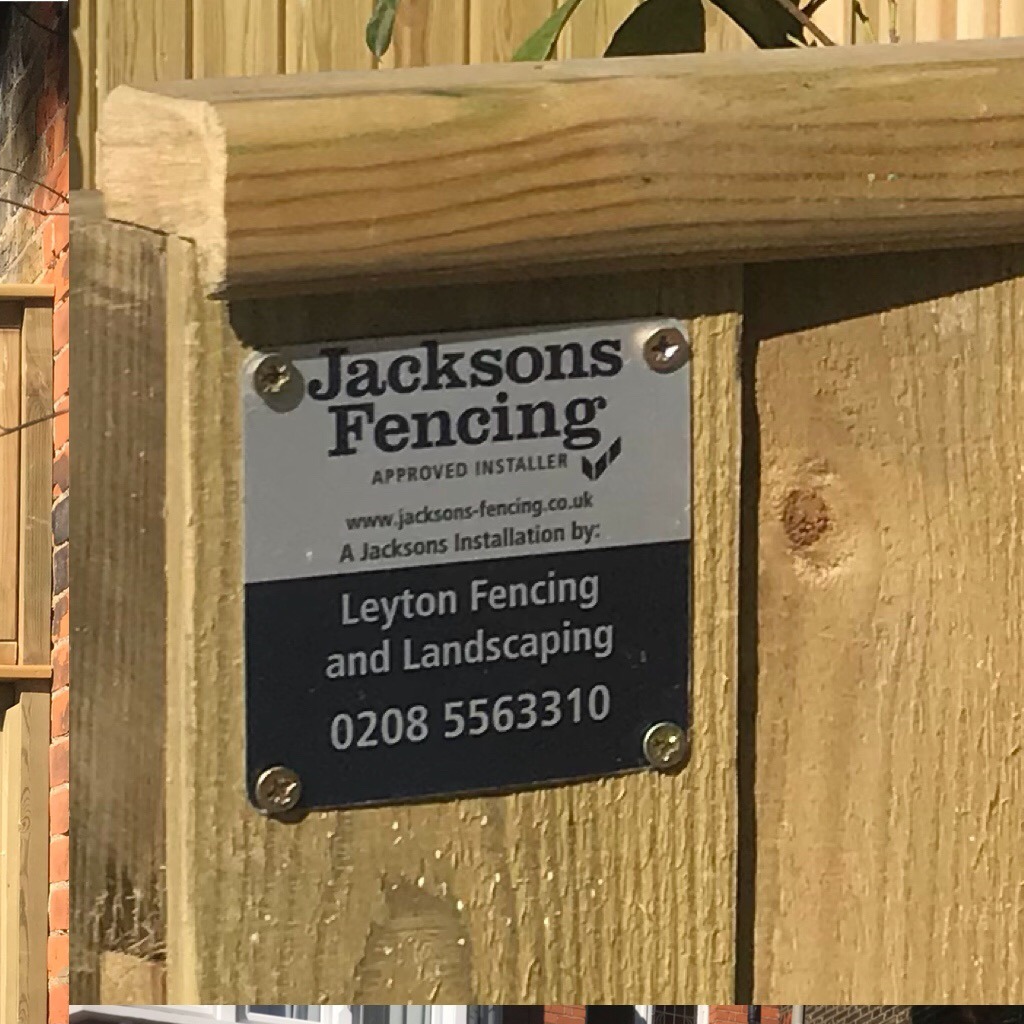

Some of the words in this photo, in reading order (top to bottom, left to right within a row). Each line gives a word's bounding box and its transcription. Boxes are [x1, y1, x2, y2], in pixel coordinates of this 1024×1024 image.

[307, 339, 623, 401] Jacksons
[328, 391, 607, 457] Fencing
[371, 462, 468, 485] APPROVED
[475, 453, 568, 476] INSTALLER
[345, 491, 593, 530] www.jacksons-fencing.co.uk
[340, 544, 354, 563] A
[360, 537, 447, 562] Jacksons
[455, 524, 565, 551] Installation
[571, 521, 600, 544] by:
[341, 588, 457, 631] Leyton
[470, 570, 599, 610] Fencing
[326, 639, 390, 679] and
[403, 621, 614, 671] Landscaping
[330, 705, 428, 750] 0208
[444, 684, 611, 738] 5563310
